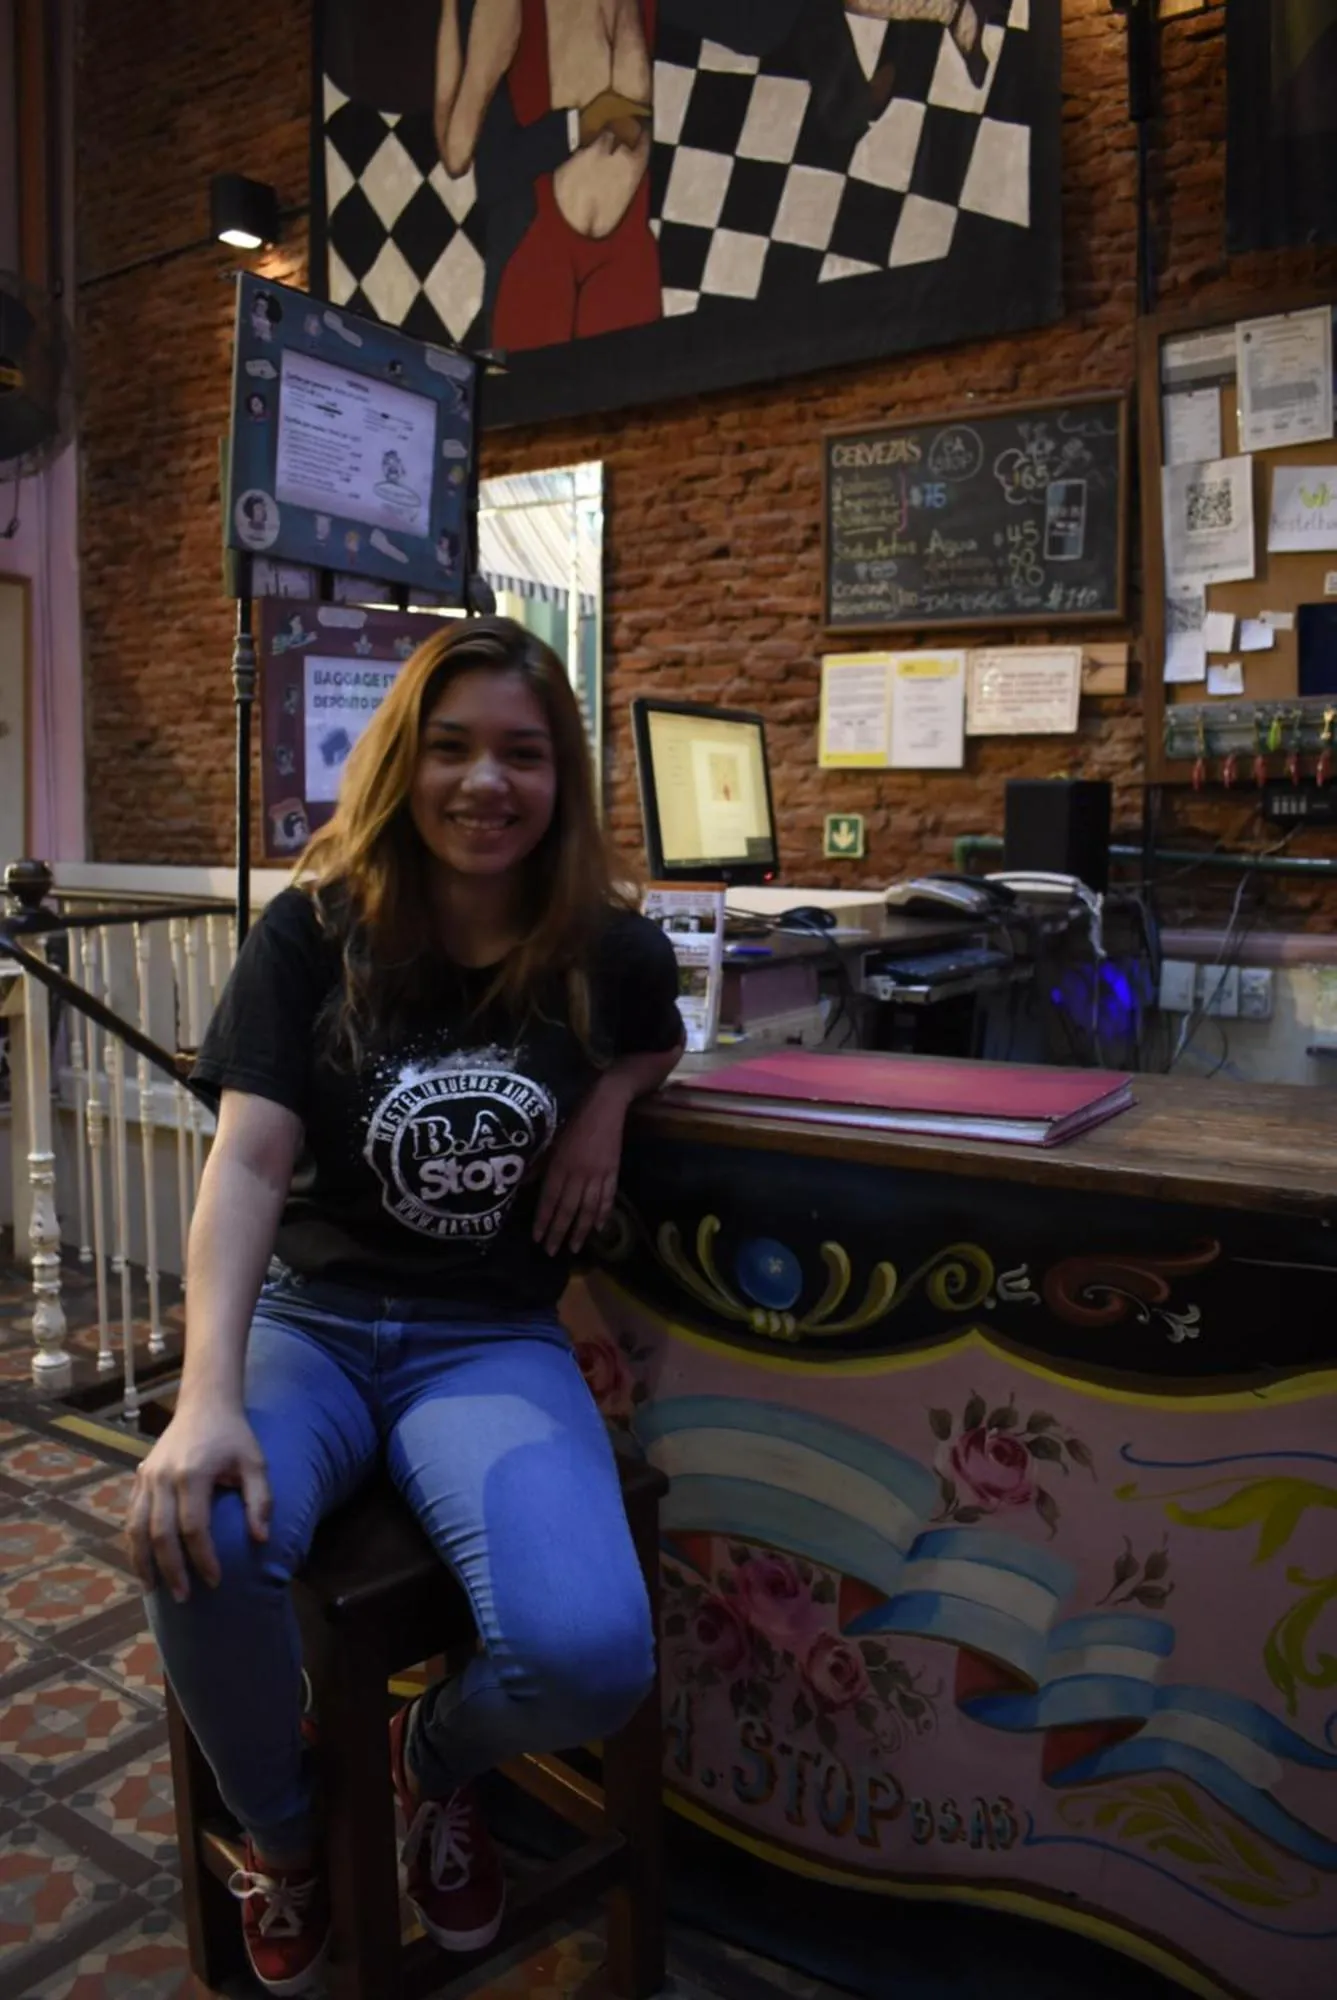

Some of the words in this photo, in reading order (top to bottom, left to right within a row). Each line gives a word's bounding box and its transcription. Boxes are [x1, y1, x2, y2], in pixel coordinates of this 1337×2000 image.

[832, 437, 922, 468] CERVEZAS
[314, 670, 380, 687] BAGGAGE
[376, 1090, 423, 1143] HOSTEL
[421, 1083, 438, 1098] IN
[439, 1075, 500, 1094] BUENOS
[502, 1083, 545, 1118] AIRES
[732, 1716, 904, 1849] STOP
